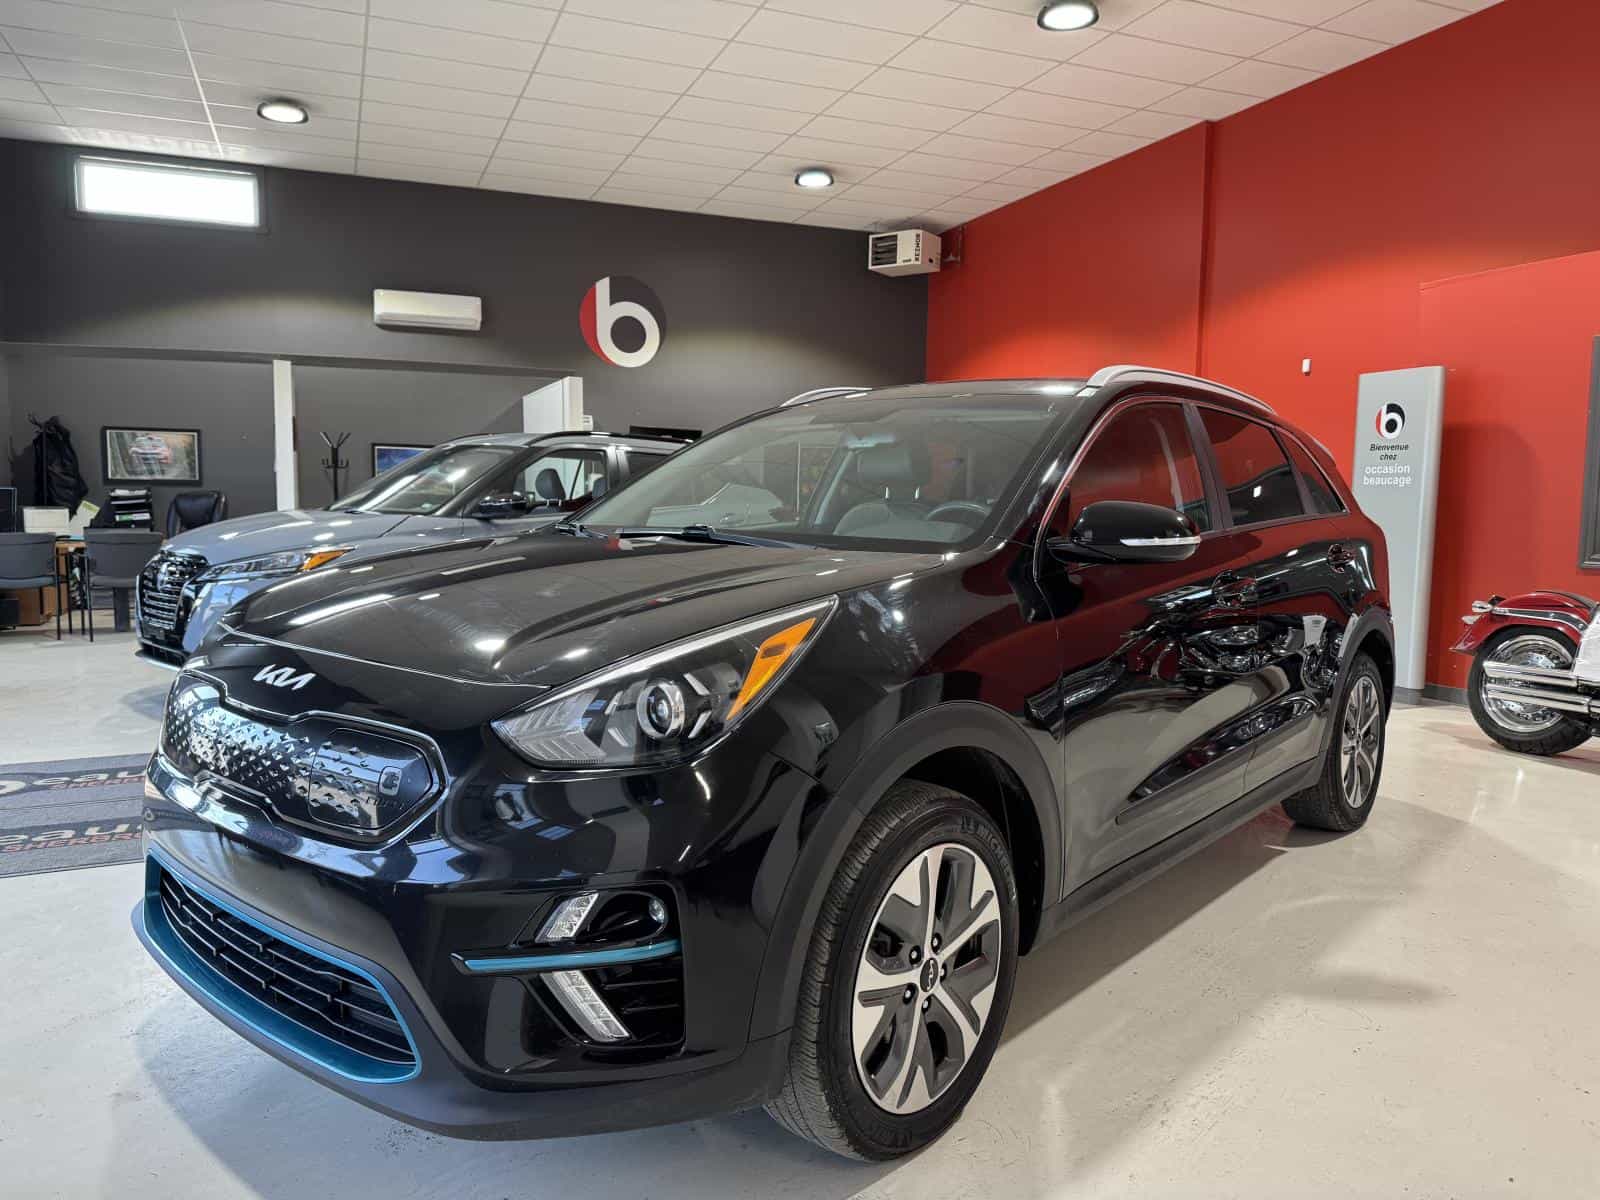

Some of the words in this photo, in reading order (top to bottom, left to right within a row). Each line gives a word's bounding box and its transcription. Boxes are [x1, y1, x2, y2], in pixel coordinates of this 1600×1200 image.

[596, 276, 660, 368] b
[1369, 443, 1409, 452] Bienvenue
[1379, 453, 1398, 461] chez
[1364, 464, 1411, 475] occasion
[1363, 475, 1412, 487] beaucage
